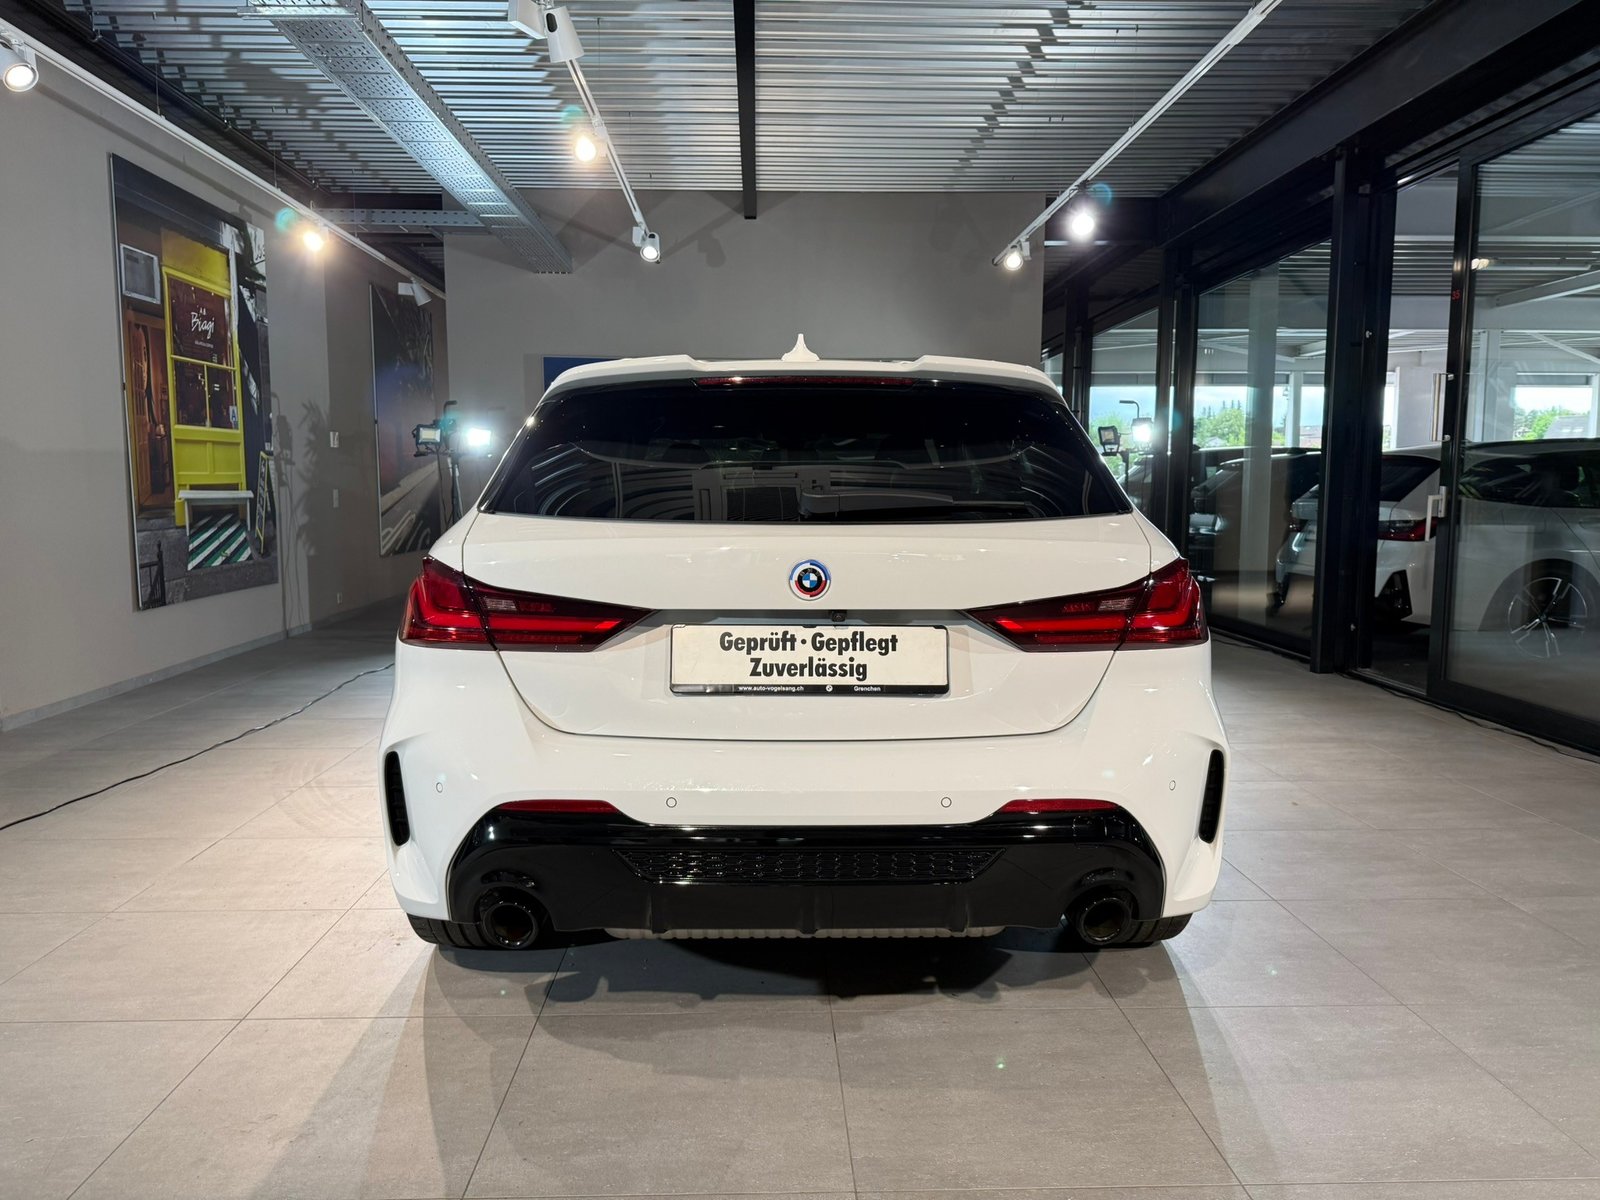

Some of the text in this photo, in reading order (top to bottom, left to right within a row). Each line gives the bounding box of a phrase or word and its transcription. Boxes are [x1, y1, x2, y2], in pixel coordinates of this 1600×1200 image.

[190, 311, 215, 339] Biagi
[719, 630, 797, 655] Geprüft
[811, 631, 898, 656] Gepflegt
[749, 656, 868, 681] Zuverlässig
